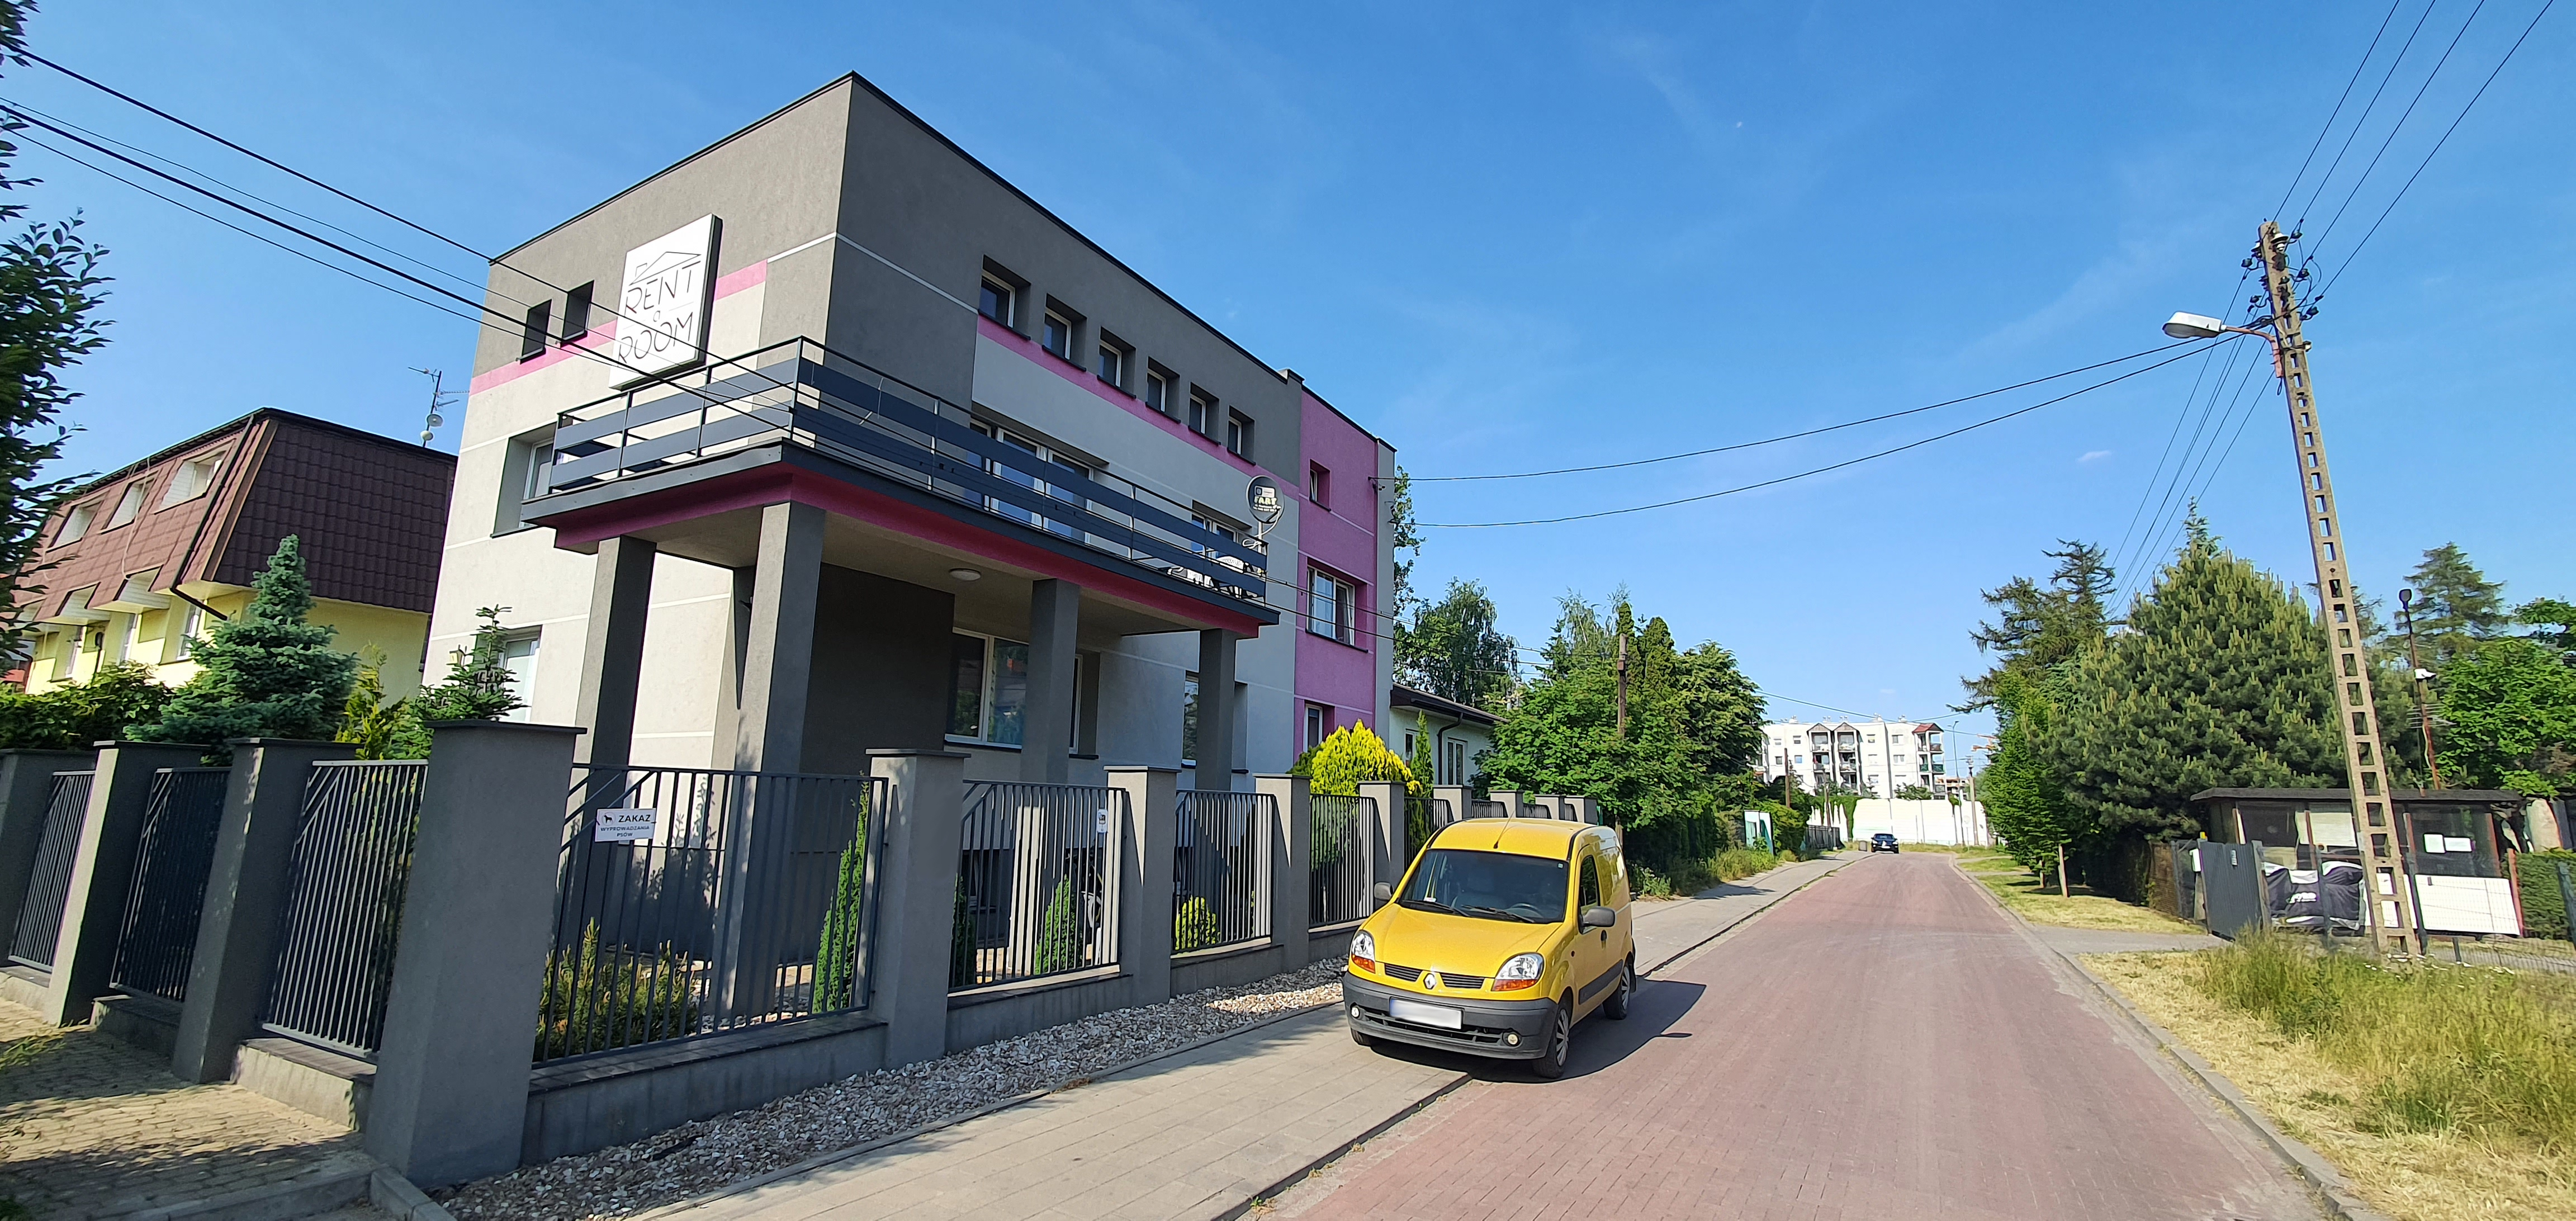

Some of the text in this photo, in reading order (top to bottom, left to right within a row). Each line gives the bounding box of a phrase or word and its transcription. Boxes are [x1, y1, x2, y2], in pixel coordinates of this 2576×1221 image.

[624, 261, 700, 316] RENT
[618, 312, 693, 364] ROOM
[1254, 496, 1277, 505] FART
